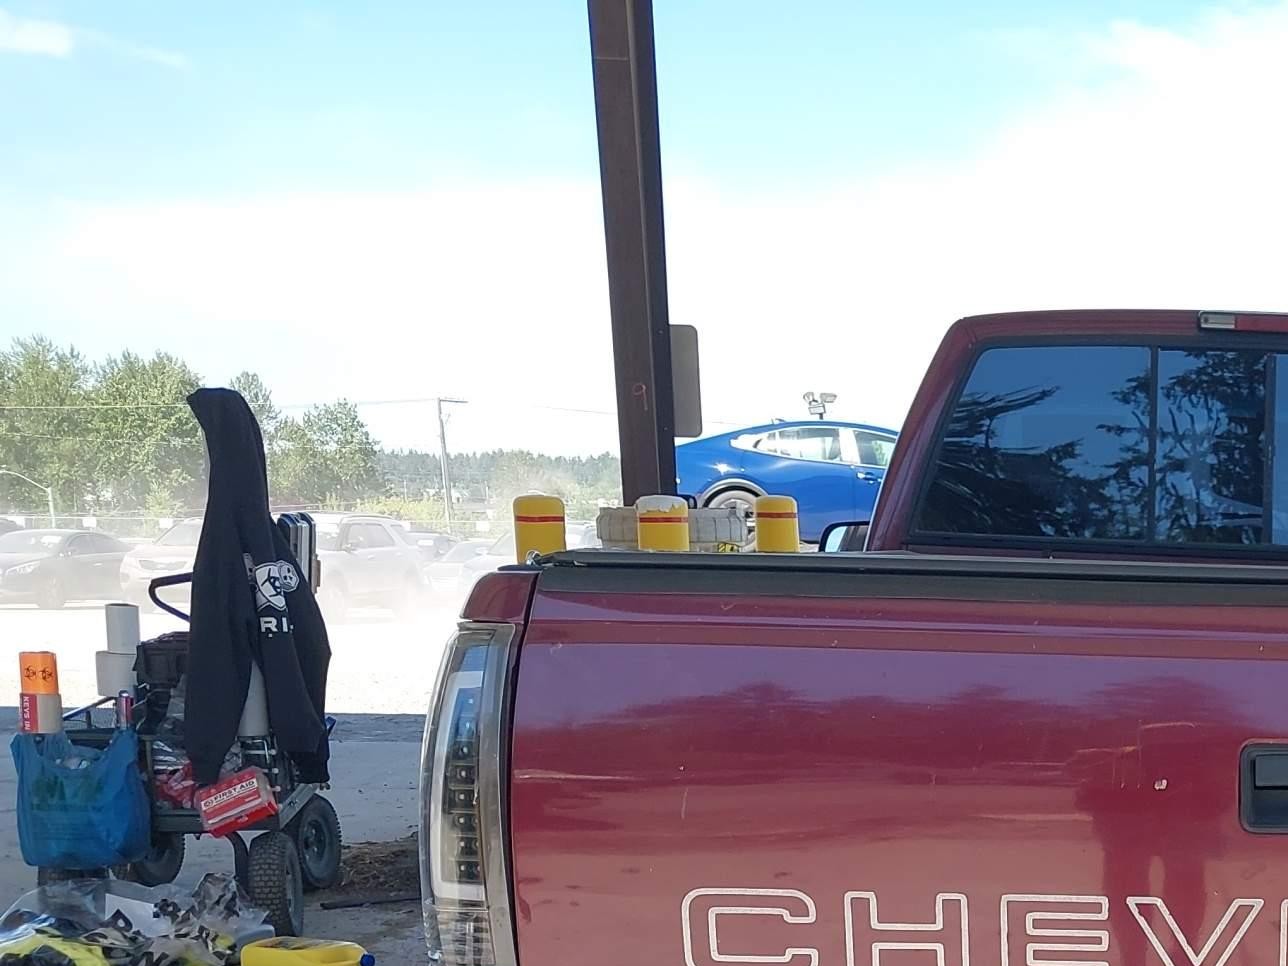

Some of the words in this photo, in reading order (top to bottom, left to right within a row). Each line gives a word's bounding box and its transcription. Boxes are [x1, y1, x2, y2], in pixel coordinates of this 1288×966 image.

[23, 721, 31, 730] IN
[213, 787, 238, 801] FIRST
[239, 780, 256, 791] AID
